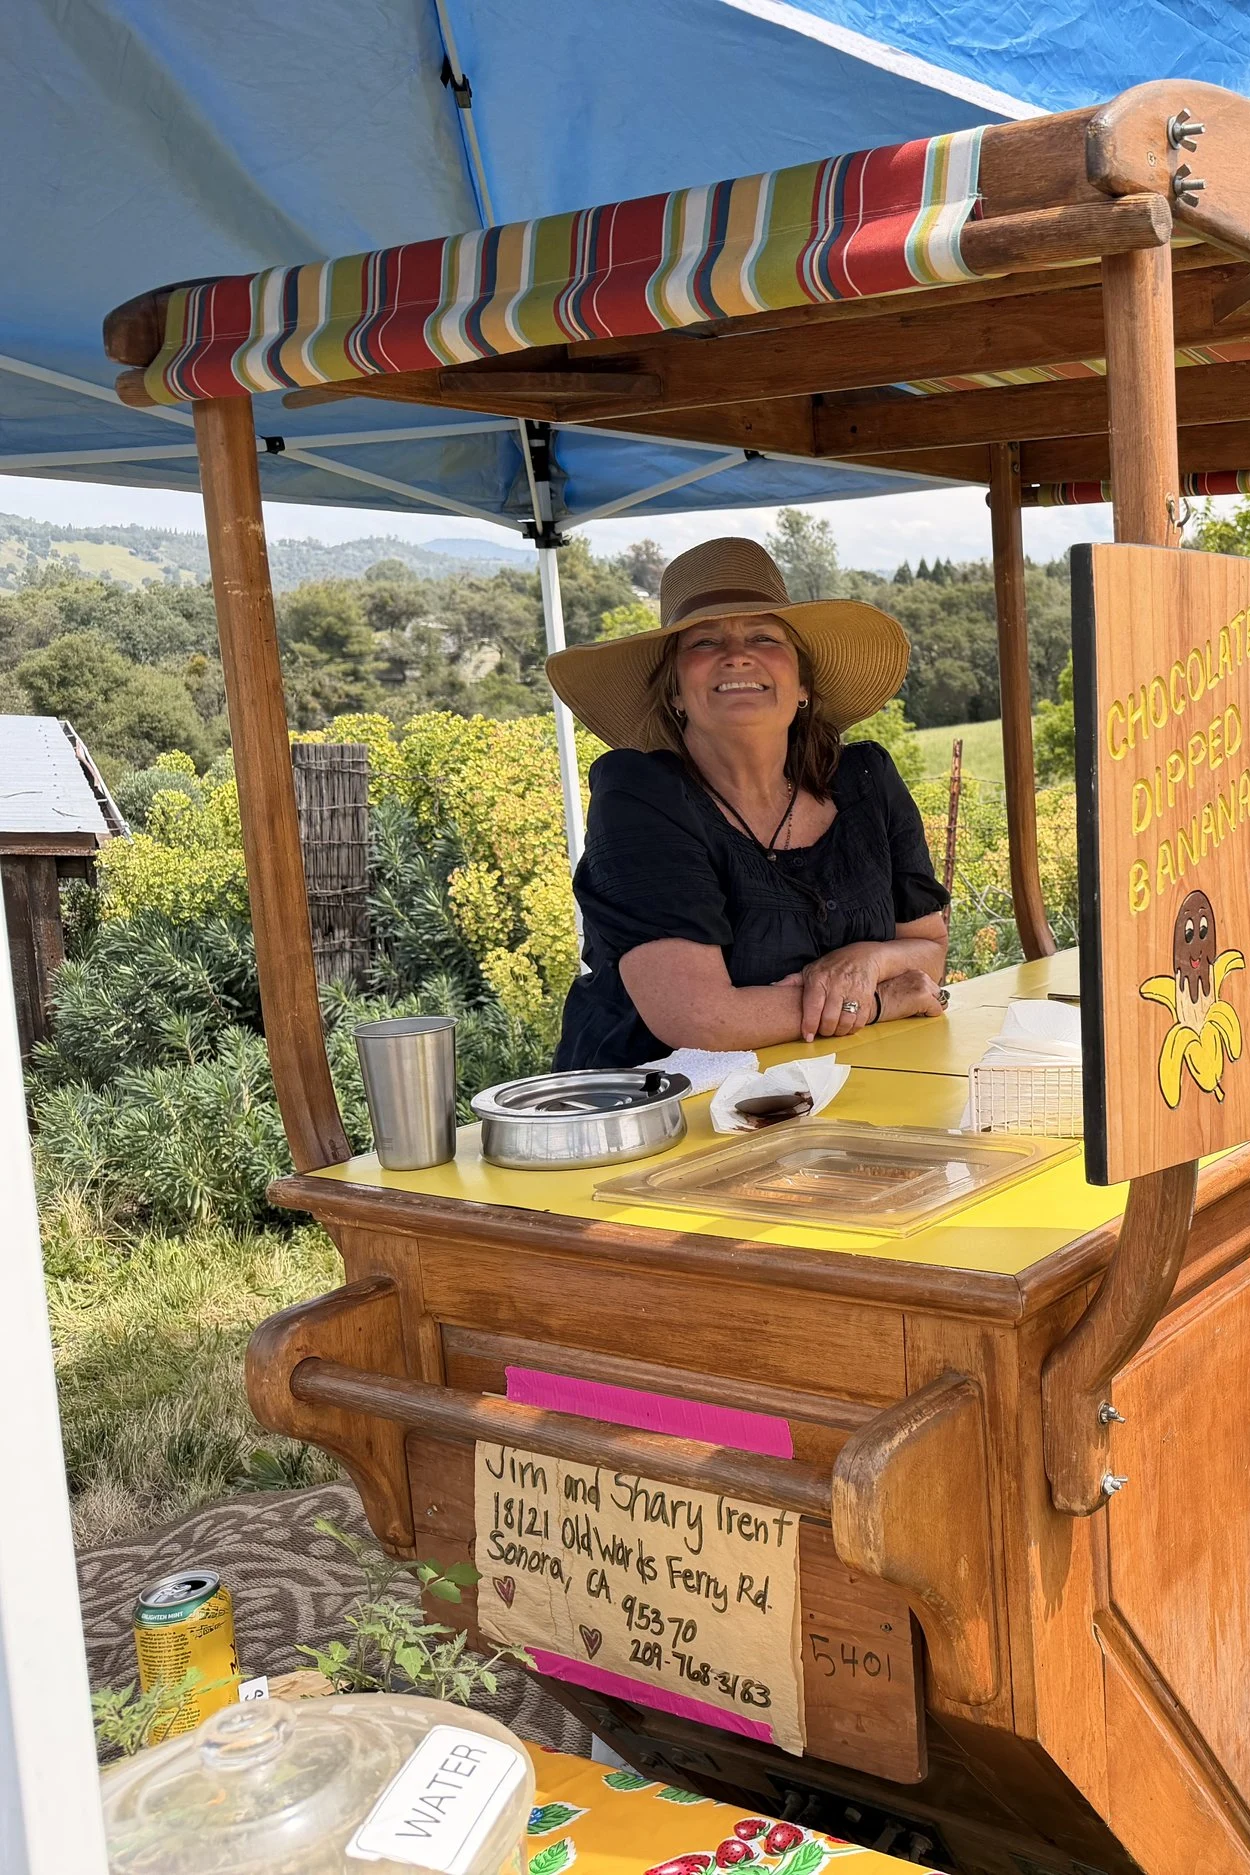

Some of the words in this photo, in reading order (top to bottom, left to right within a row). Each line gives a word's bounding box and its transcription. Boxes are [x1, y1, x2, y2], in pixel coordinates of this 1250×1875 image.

[1132, 703, 1243, 836] DIPPED
[493, 1491, 550, 1540] 18121
[665, 1555, 728, 1613] Ferry
[563, 1467, 600, 1513] and
[610, 1472, 704, 1555] Shary
[486, 1529, 573, 1594] Sonora,
[168, 1610, 184, 1620] MINT
[808, 1633, 892, 1682] 5401
[394, 1743, 488, 1838] WATER
